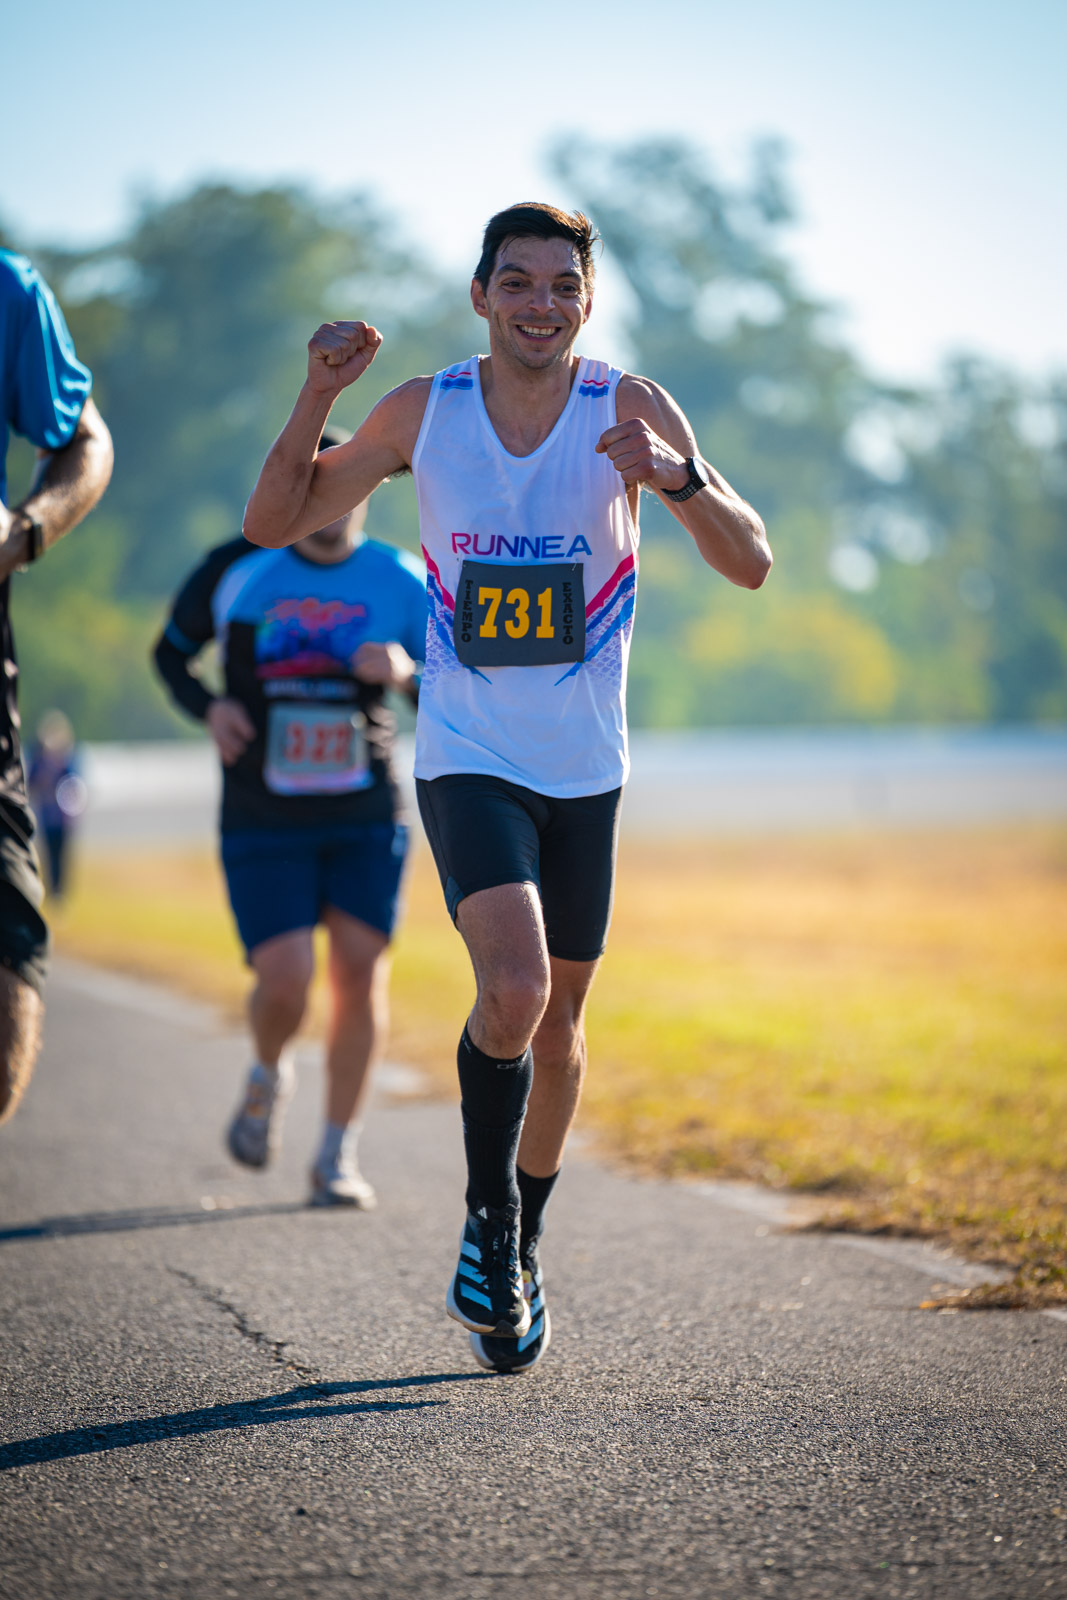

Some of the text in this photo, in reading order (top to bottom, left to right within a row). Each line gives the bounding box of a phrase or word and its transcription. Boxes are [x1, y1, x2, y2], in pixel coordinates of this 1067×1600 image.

[451, 532, 592, 558] RUNNEA
[461, 579, 473, 643] TIEMPO
[478, 586, 555, 639] 731
[562, 581, 574, 645] EXACTO
